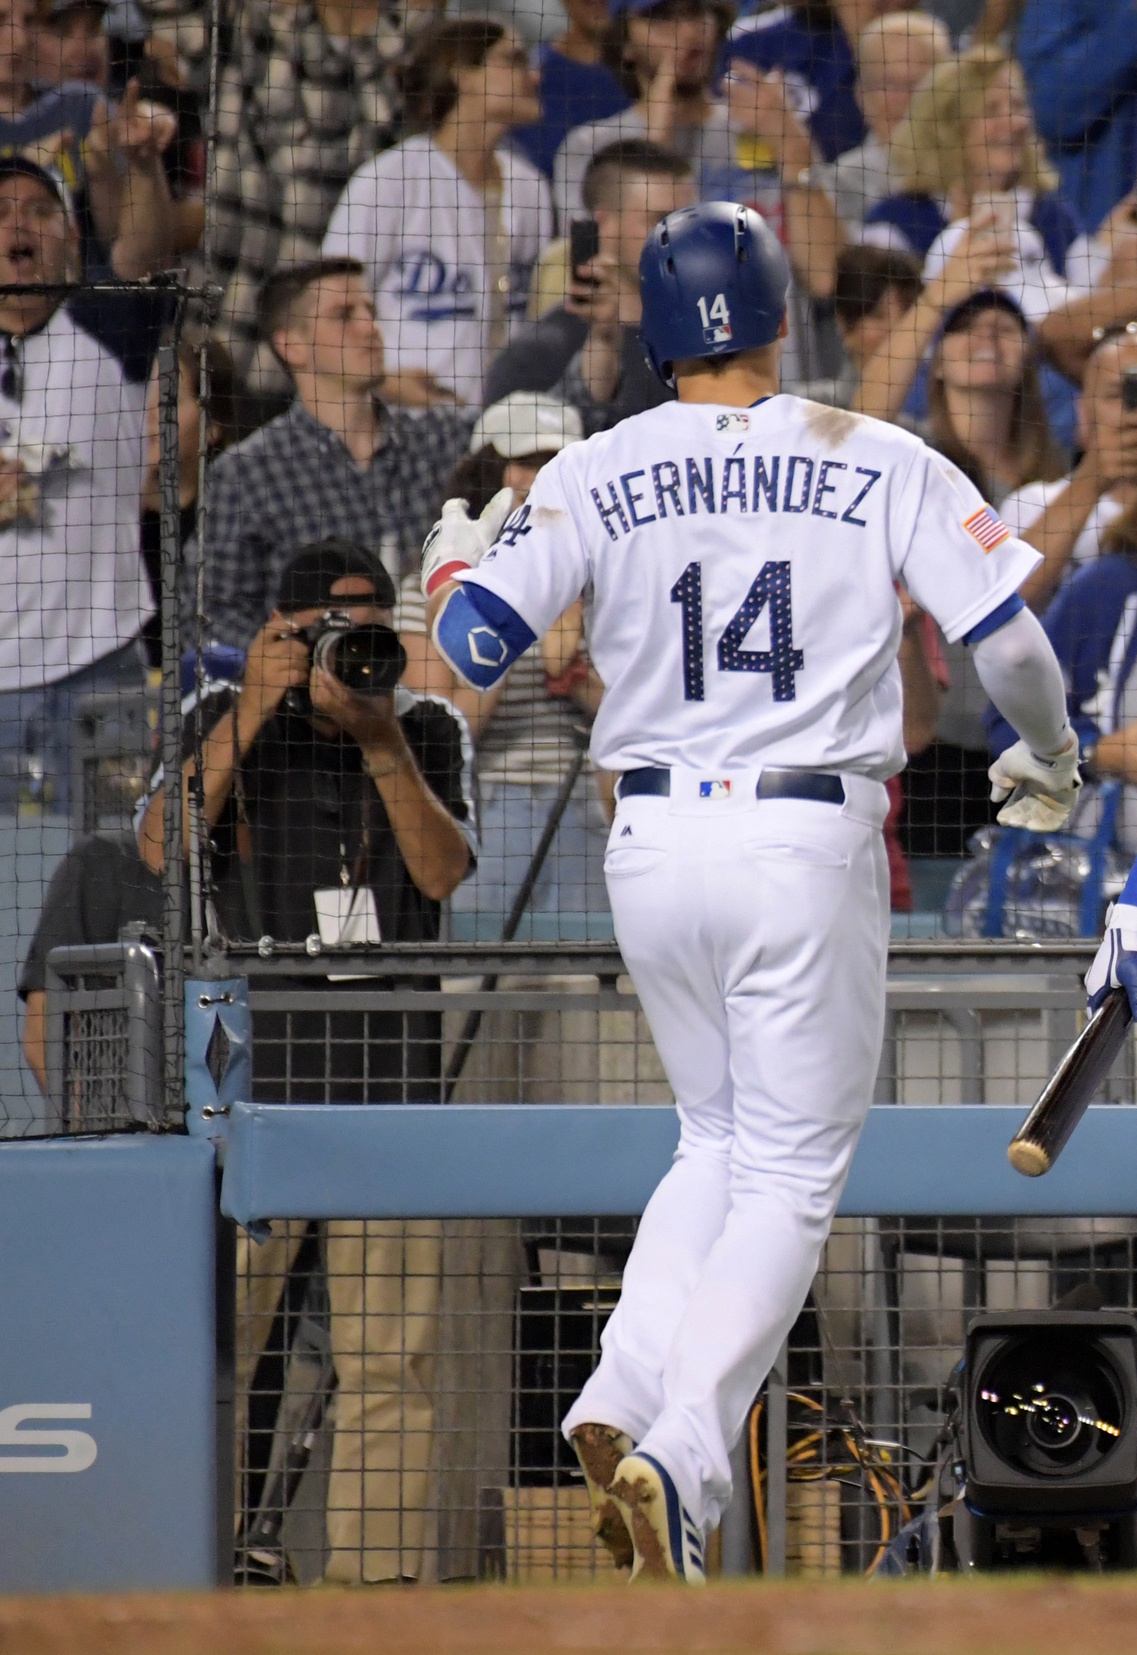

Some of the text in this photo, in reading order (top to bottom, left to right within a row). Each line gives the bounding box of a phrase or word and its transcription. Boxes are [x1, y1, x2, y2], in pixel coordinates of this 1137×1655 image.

[697, 293, 730, 328] 14
[590, 443, 882, 541] HERNÁNDEZ
[670, 560, 805, 702] 14
[0, 1403, 98, 1473] S
